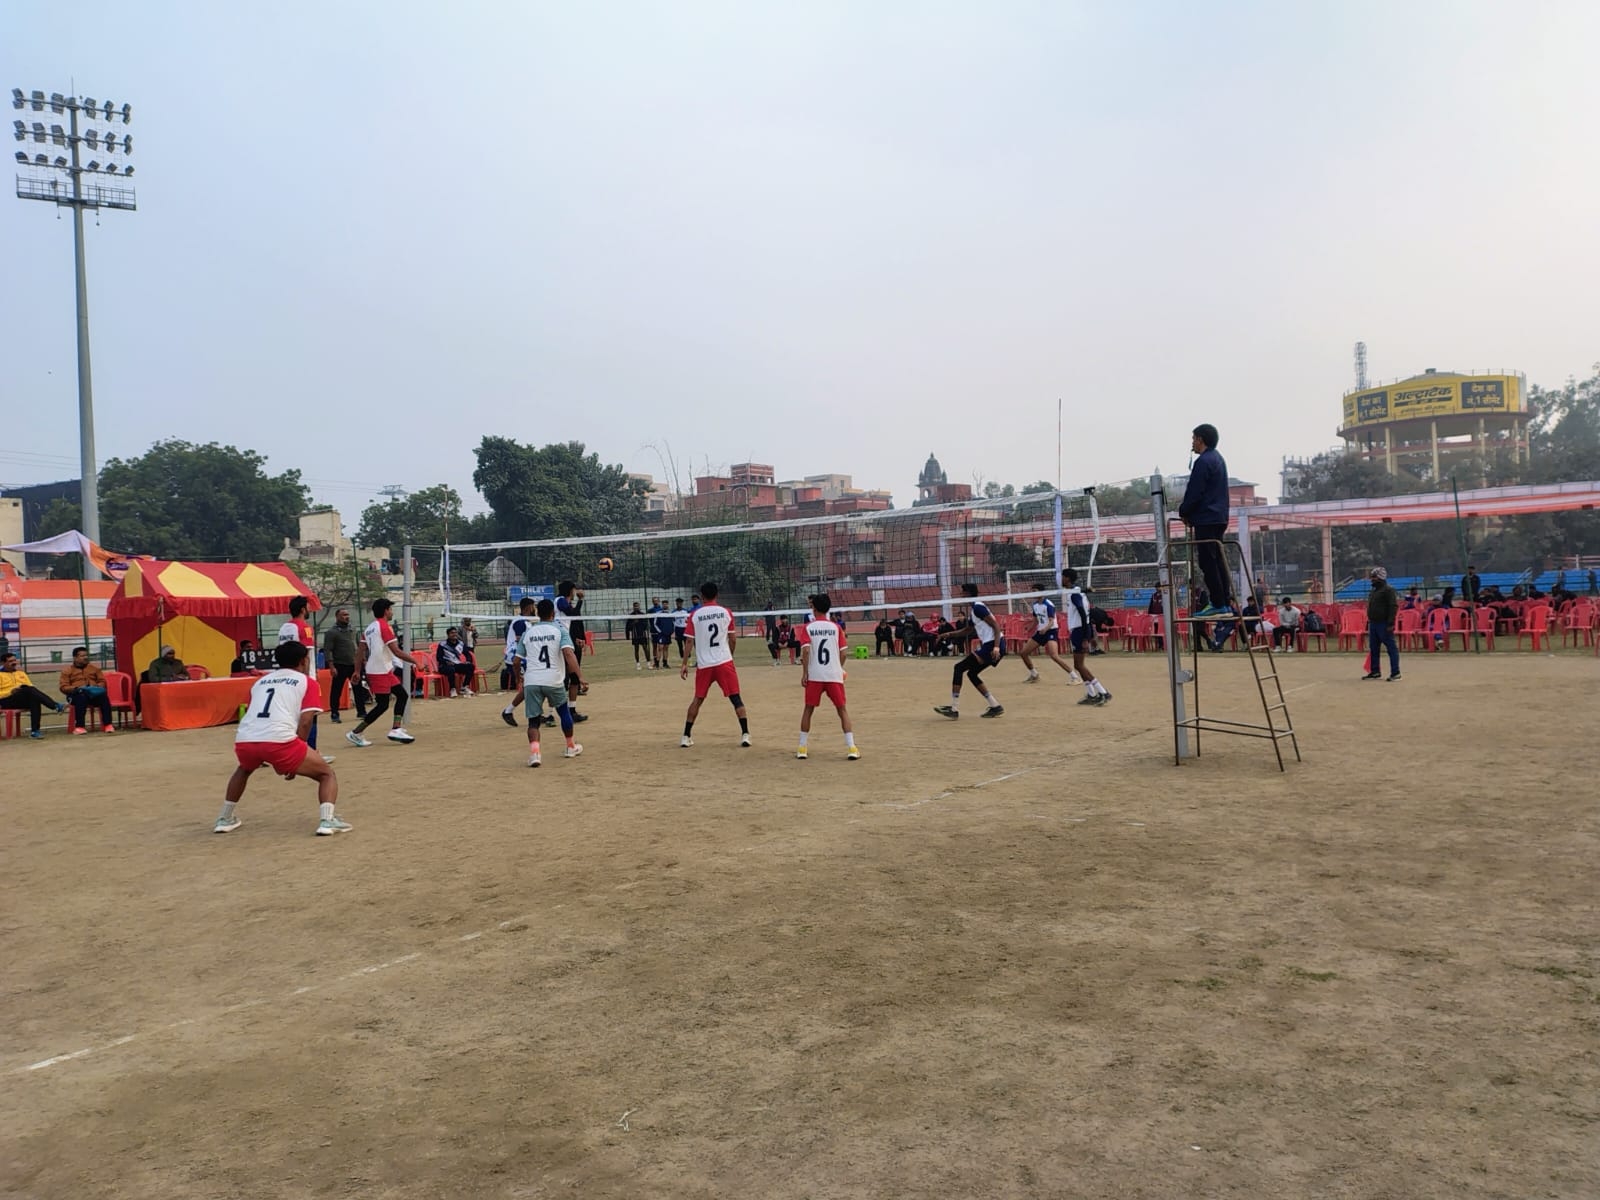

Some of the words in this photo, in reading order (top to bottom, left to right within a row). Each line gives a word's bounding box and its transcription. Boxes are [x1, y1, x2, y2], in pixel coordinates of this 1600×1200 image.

[697, 612, 725, 621] MANIPUR
[529, 634, 556, 642] MANIPUR
[708, 623, 720, 647] 2
[241, 650, 256, 664] 18
[538, 645, 551, 669] 4
[817, 638, 830, 666] 6
[260, 678, 299, 686] MANIPUR
[256, 687, 275, 718] 1
